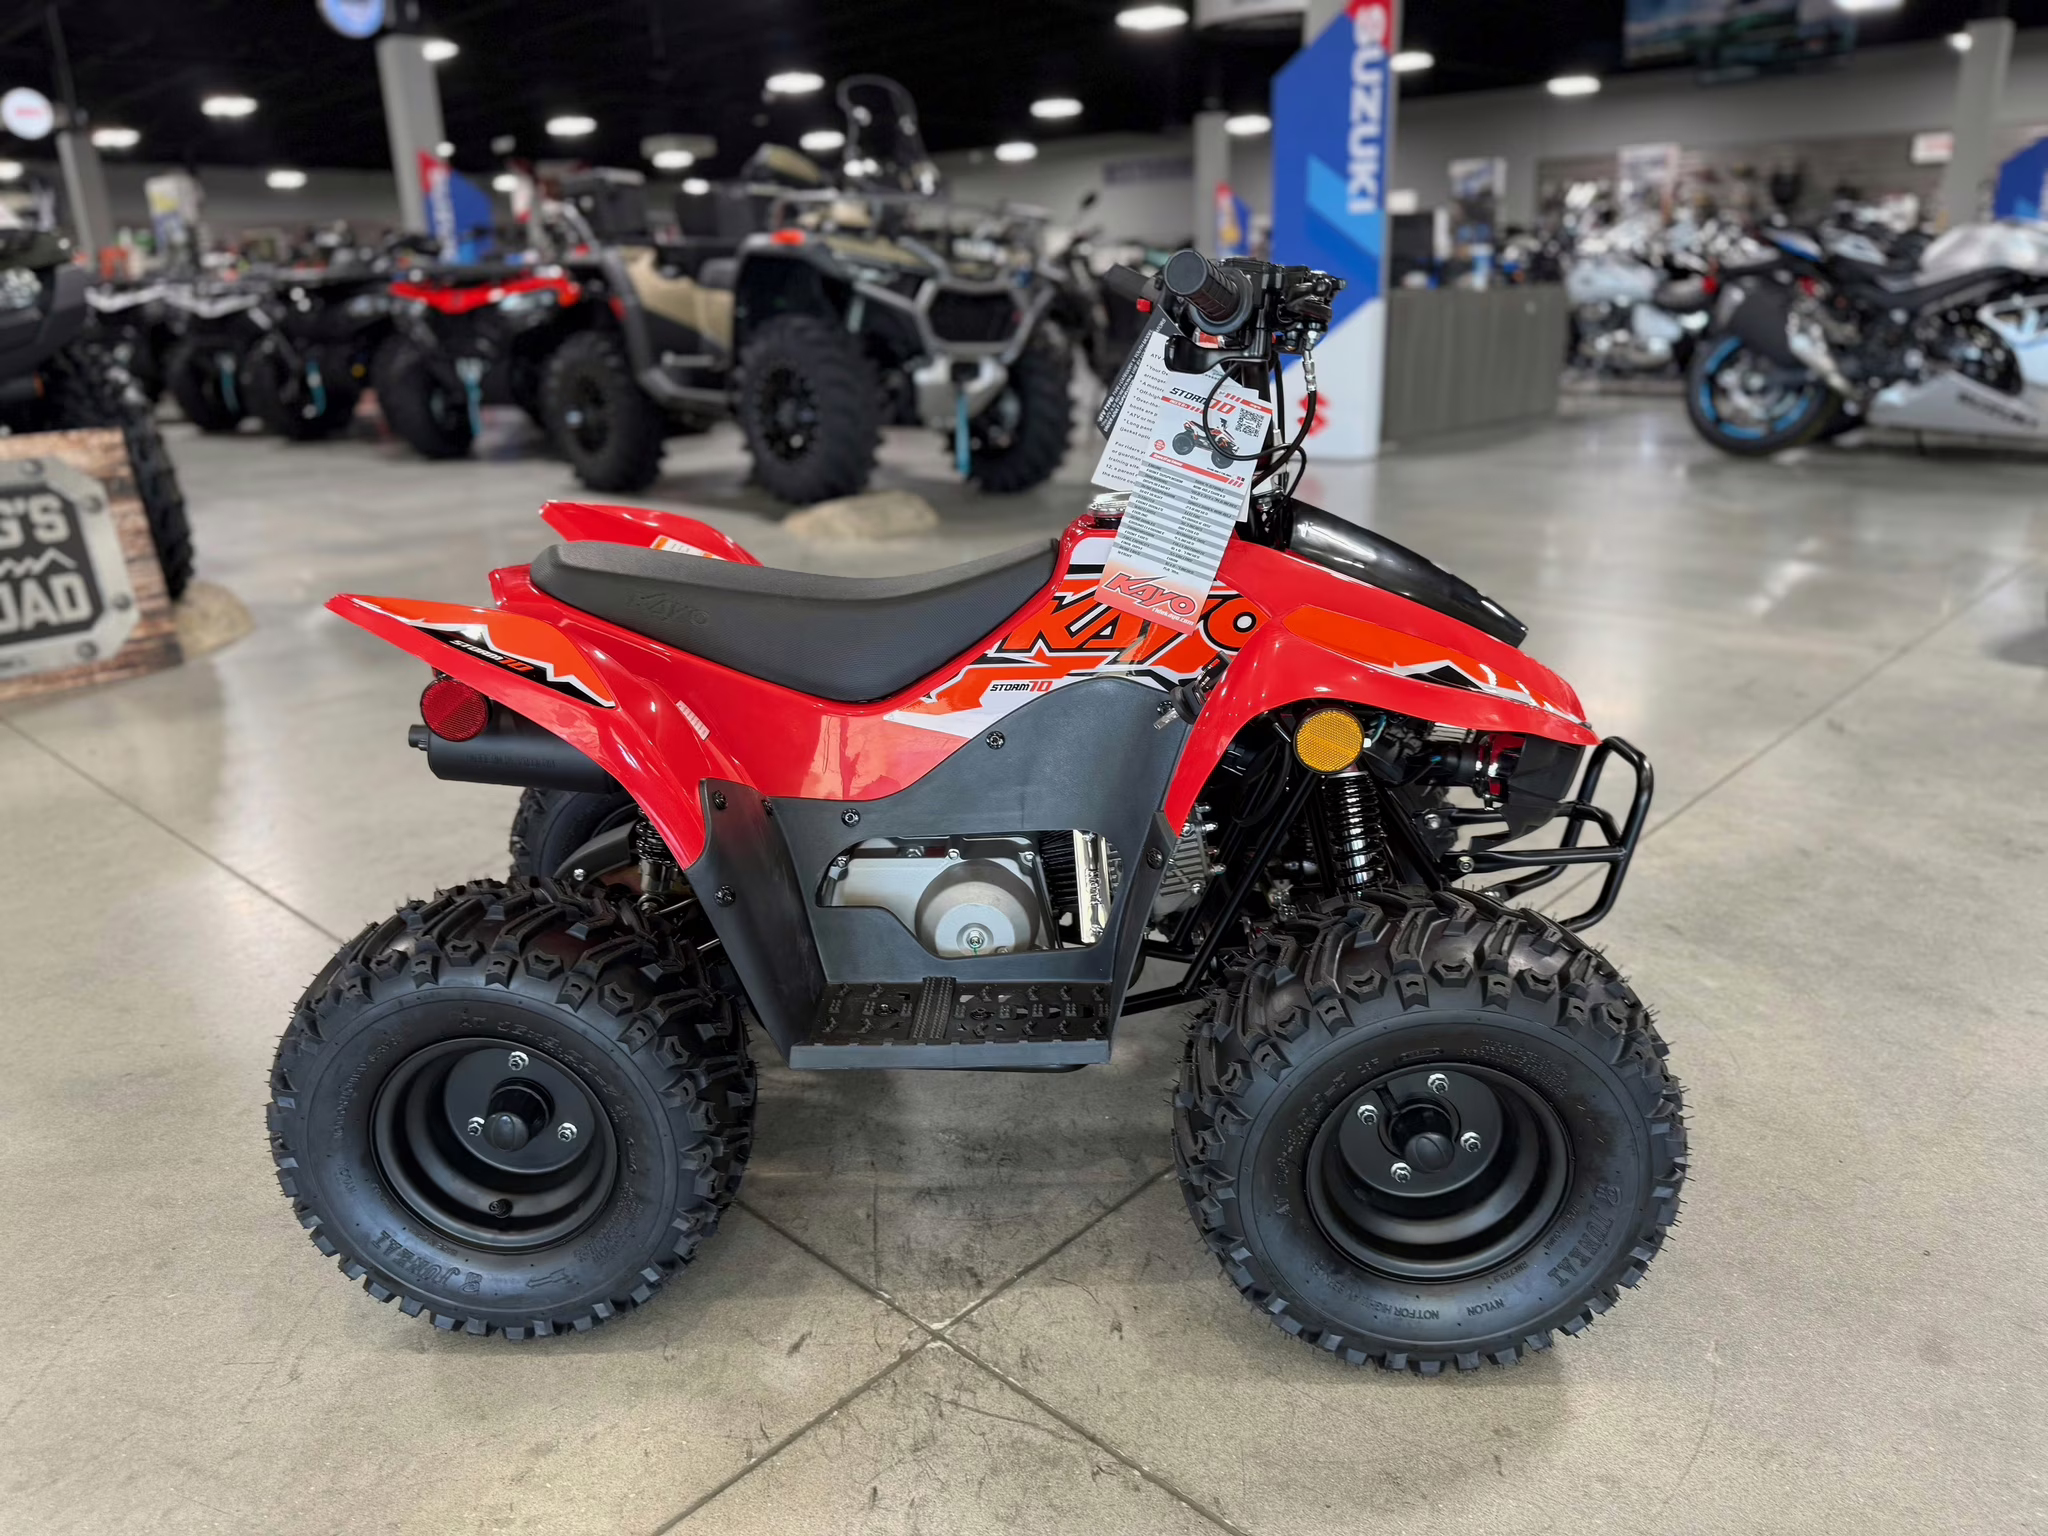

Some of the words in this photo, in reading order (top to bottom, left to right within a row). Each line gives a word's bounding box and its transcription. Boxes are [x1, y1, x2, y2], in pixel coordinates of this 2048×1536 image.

[1347, 3, 1388, 216] SUZUKI
[1102, 573, 1198, 617] KAYO
[449, 640, 534, 671] STORM70
[990, 681, 1053, 692] STORM70
[1466, 1298, 1505, 1316] NYLON
